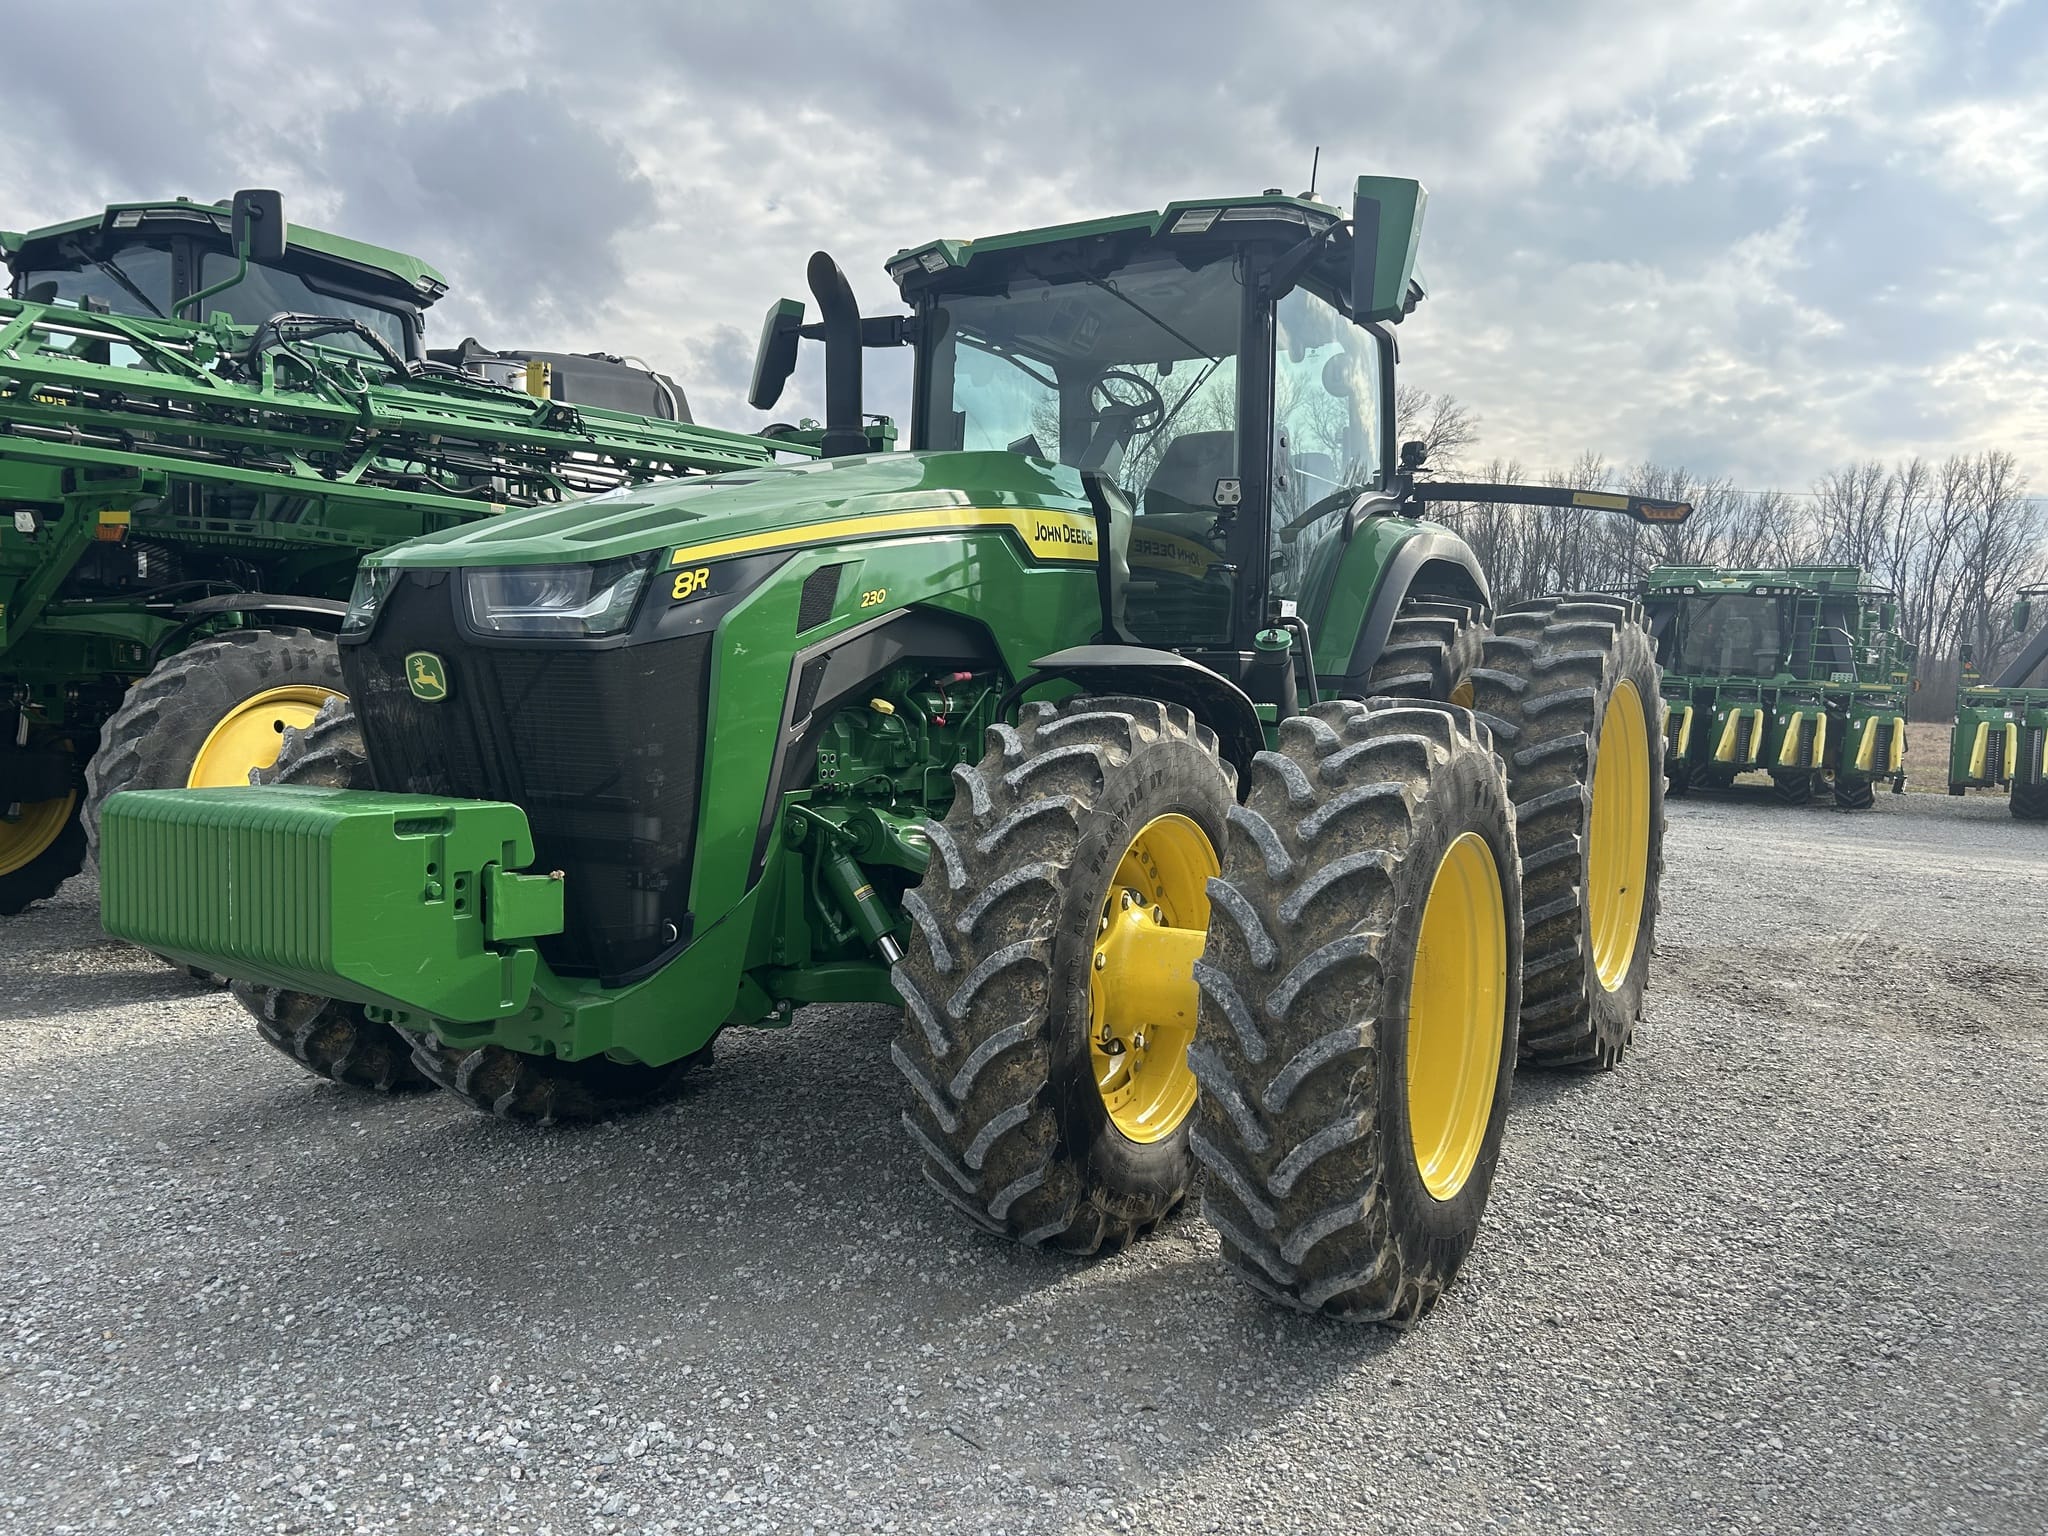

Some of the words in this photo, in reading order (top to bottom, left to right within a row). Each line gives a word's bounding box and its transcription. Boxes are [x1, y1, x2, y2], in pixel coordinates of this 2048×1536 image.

[1035, 521, 1062, 543] JOHN
[1062, 524, 1094, 546] DEERE
[671, 567, 711, 600] 8R
[860, 588, 887, 608] 230
